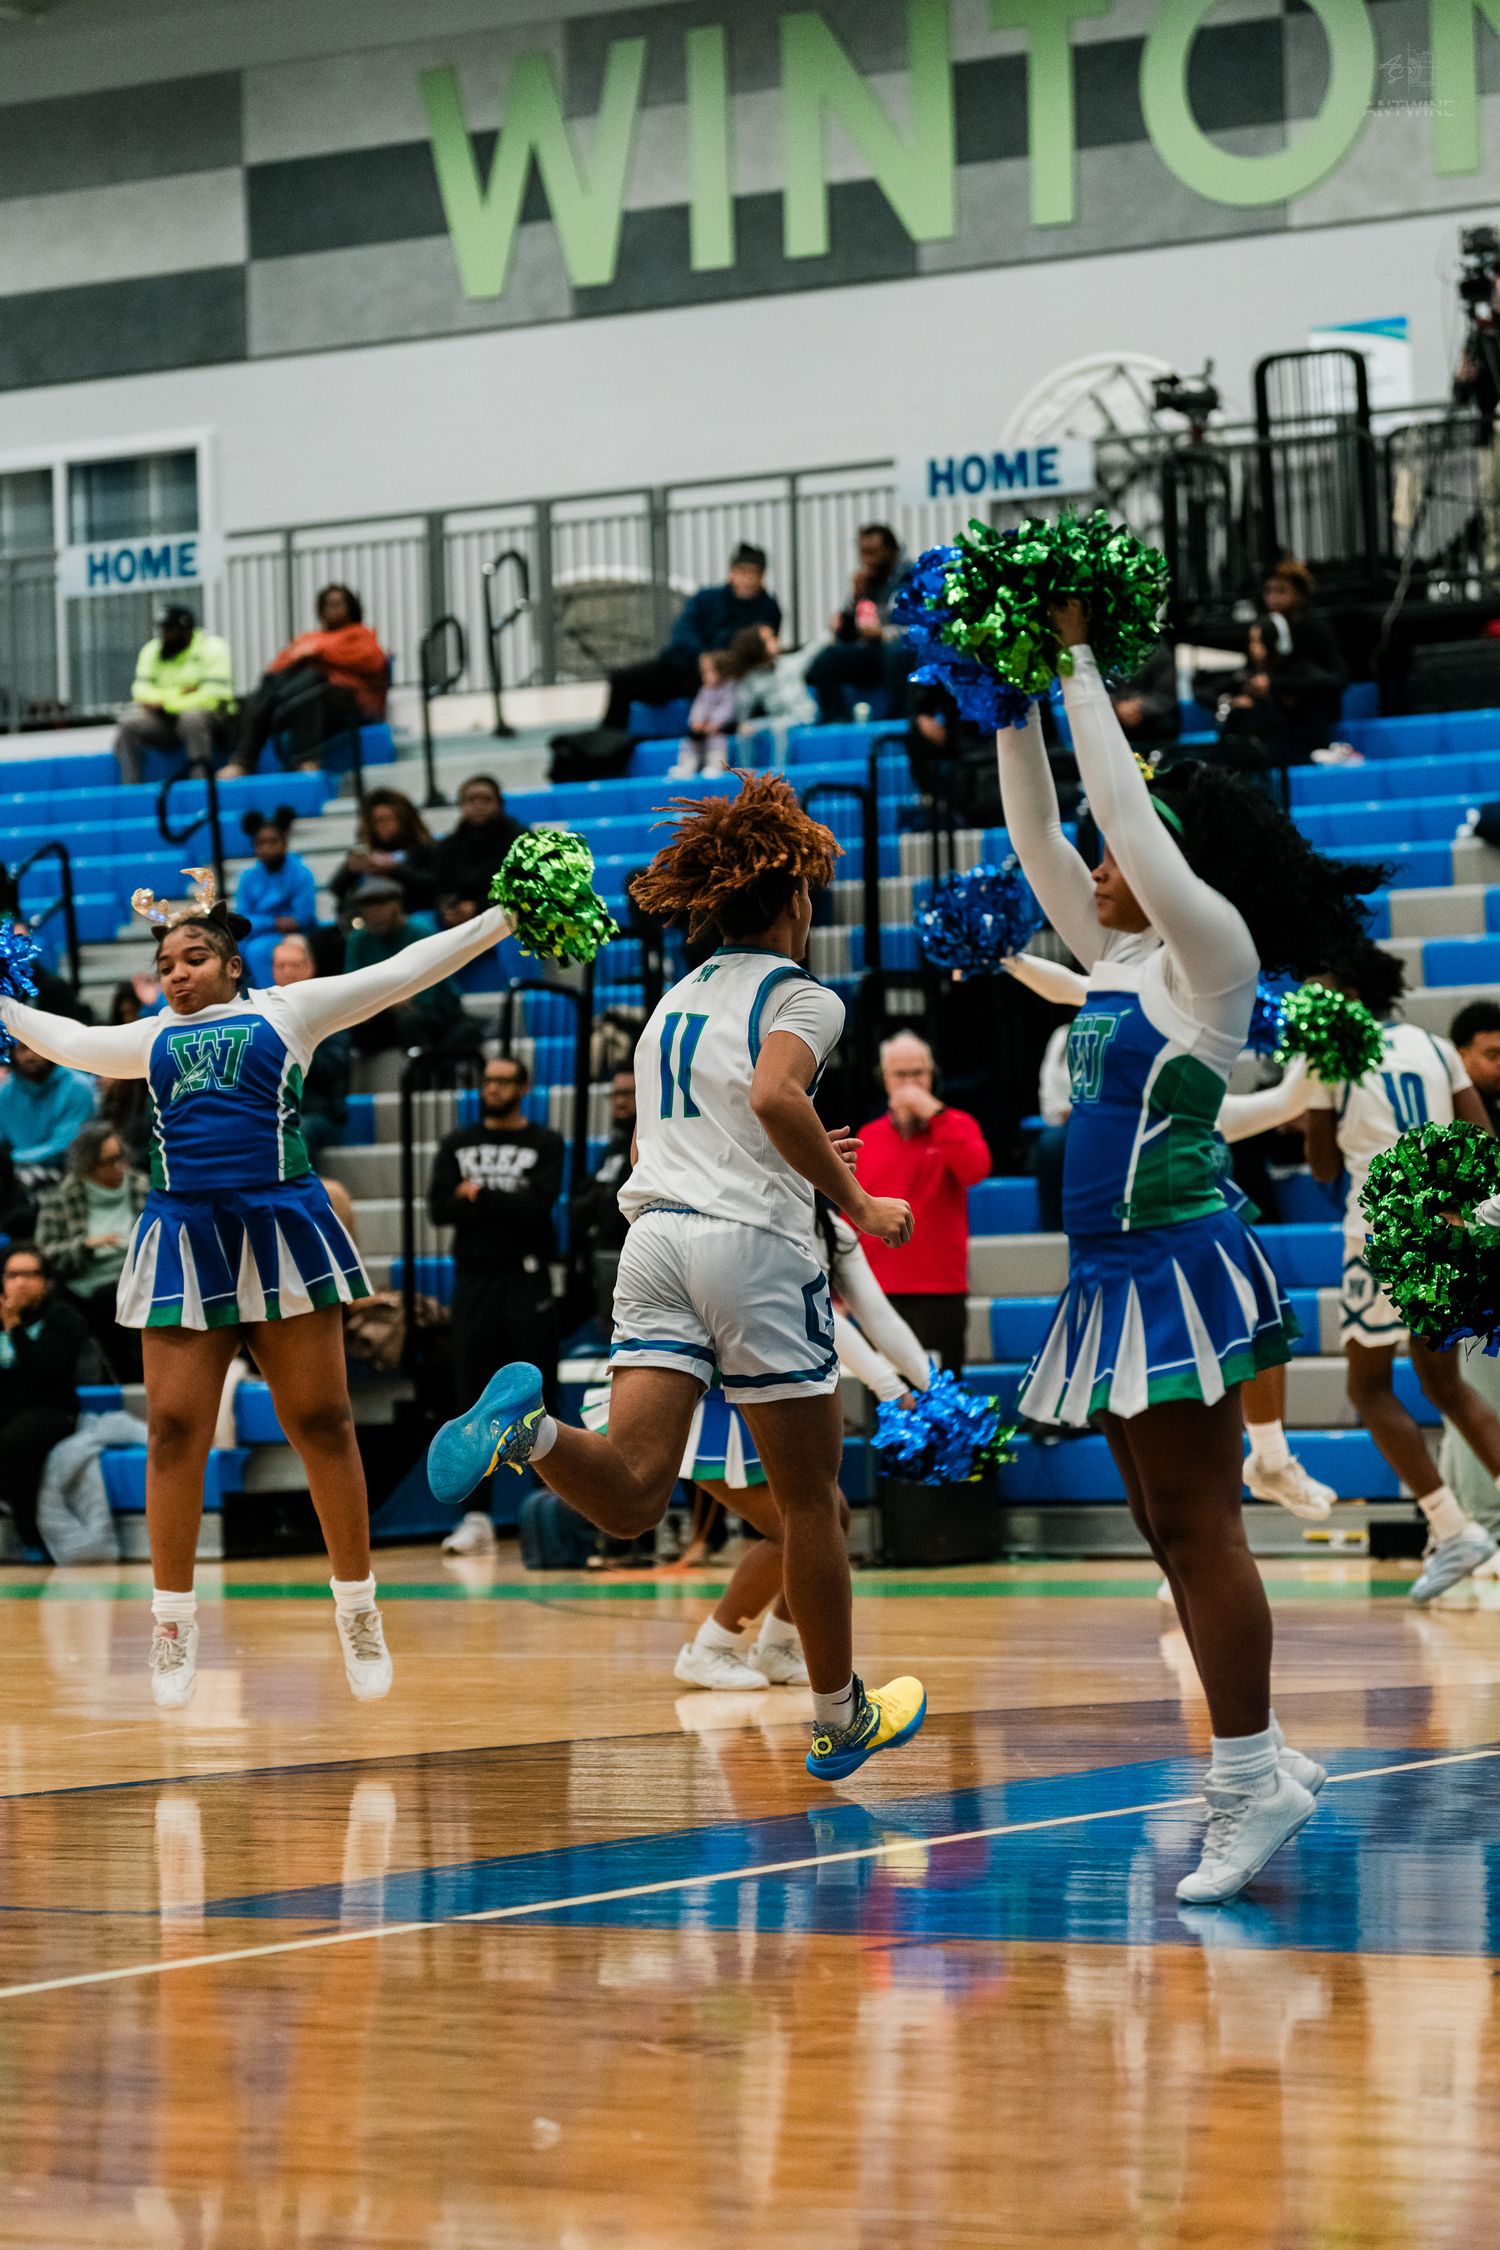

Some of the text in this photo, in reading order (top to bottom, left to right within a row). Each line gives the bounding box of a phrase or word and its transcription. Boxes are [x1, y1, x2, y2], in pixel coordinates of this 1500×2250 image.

[929, 447, 1060, 497] HOME
[87, 542, 197, 587] HOME
[167, 1025, 254, 1095] W
[659, 1011, 709, 1121] 11
[1380, 1071, 1428, 1133] 10
[454, 1144, 538, 1178] KEEP
